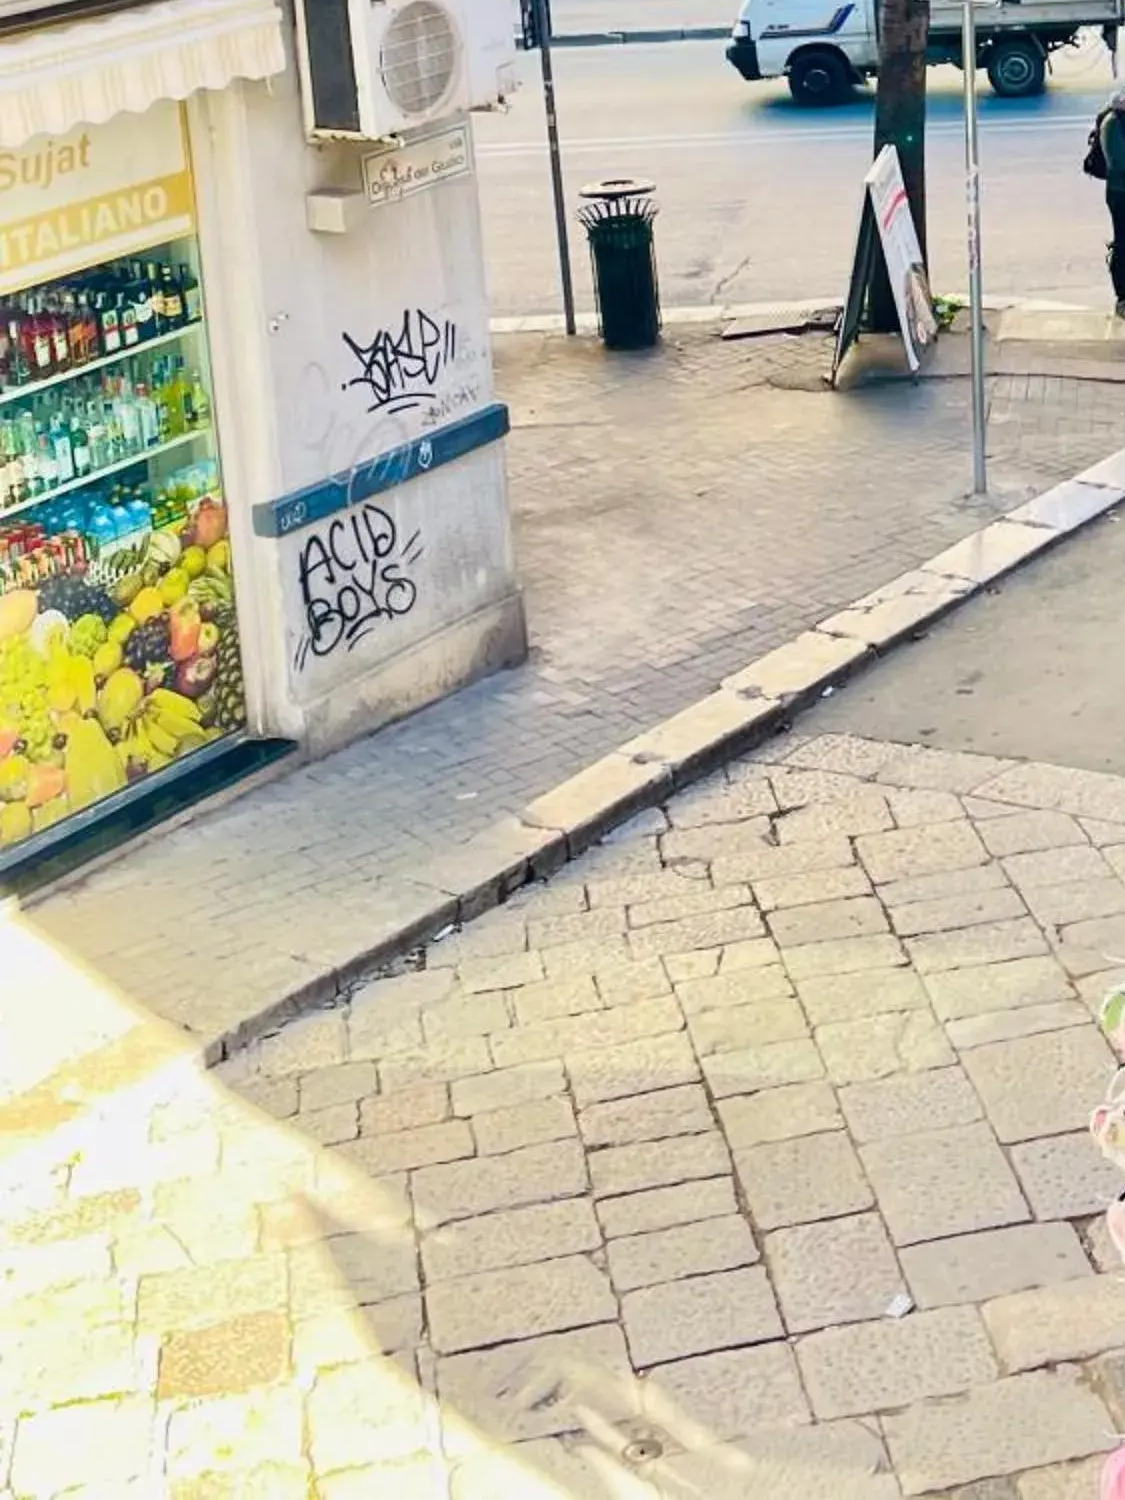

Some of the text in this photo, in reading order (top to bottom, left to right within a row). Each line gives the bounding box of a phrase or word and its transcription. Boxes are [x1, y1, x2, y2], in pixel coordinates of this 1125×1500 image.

[0, 132, 90, 191] Sujat
[0, 185, 168, 268] ITALIANO
[299, 503, 397, 604] ACID
[307, 559, 417, 656] BOYS
